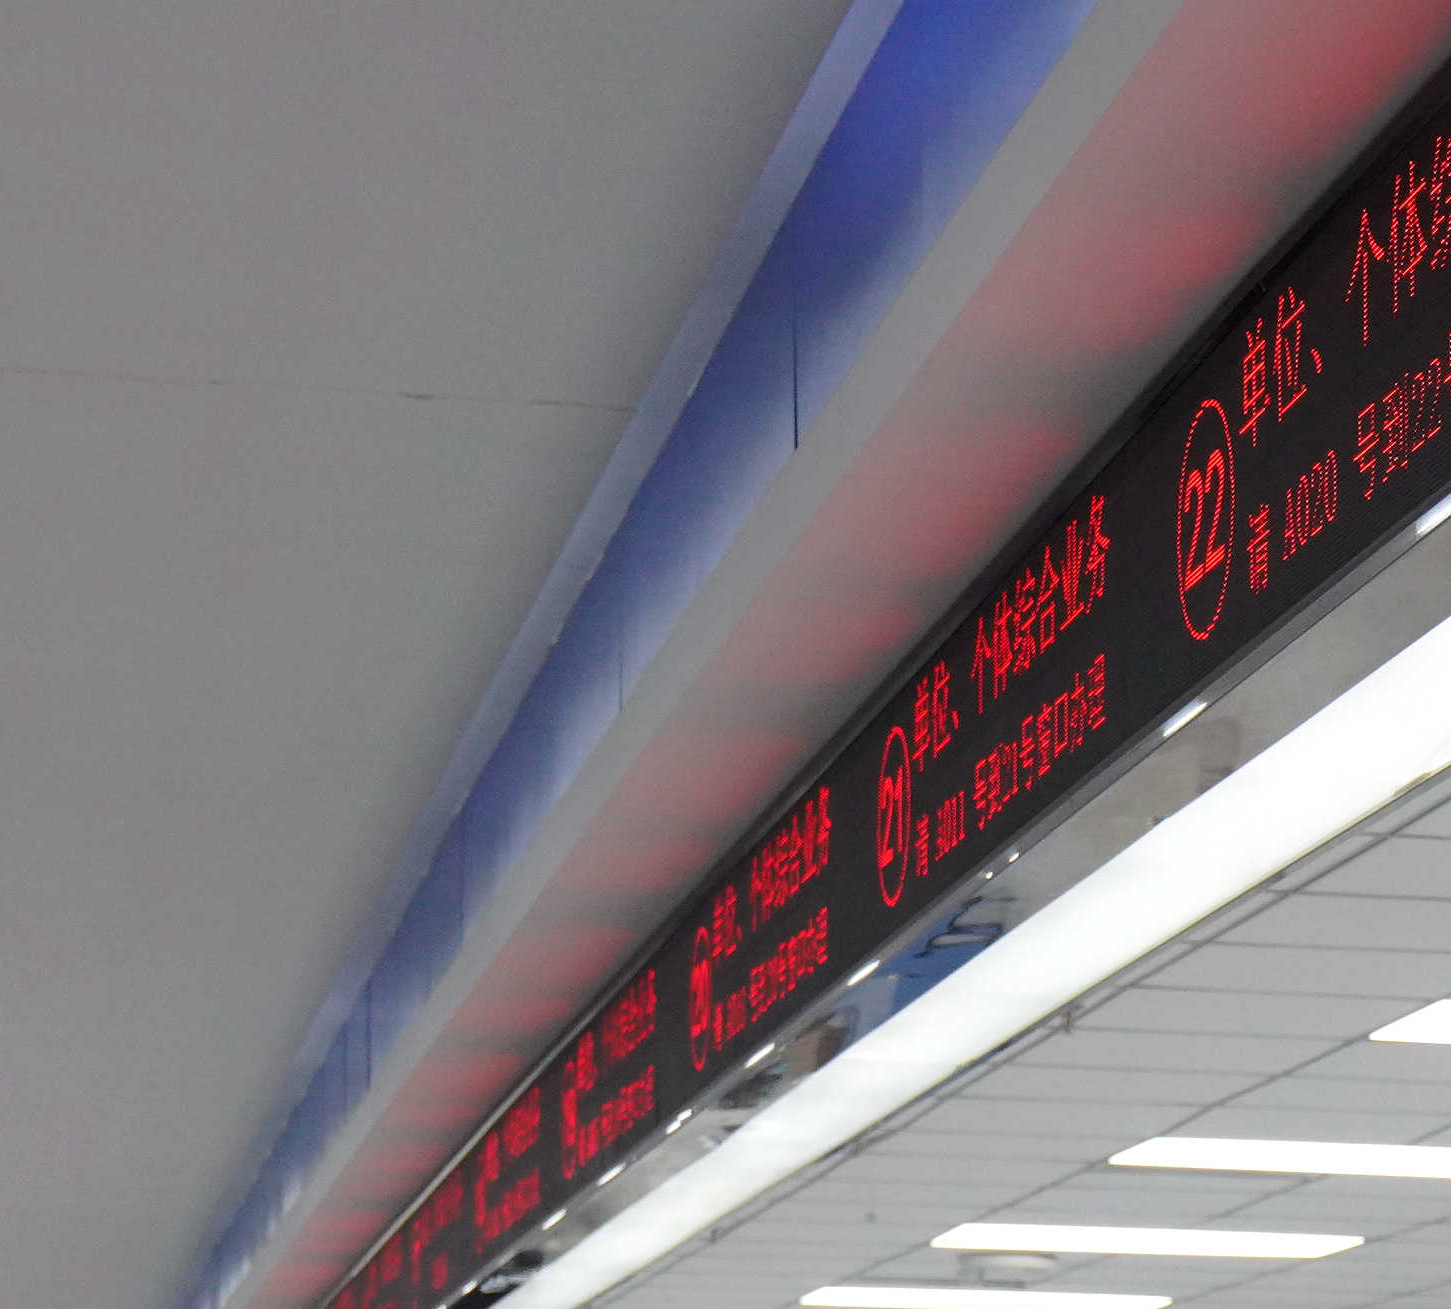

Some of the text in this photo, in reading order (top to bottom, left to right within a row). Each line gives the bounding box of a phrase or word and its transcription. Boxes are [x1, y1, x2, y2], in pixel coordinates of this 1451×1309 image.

[1246, 504, 1271, 594] 请
[1282, 450, 1337, 560] A020
[912, 496, 1110, 771] 单位、个体综合业务
[973, 654, 1106, 830] 号到21号窗口办理
